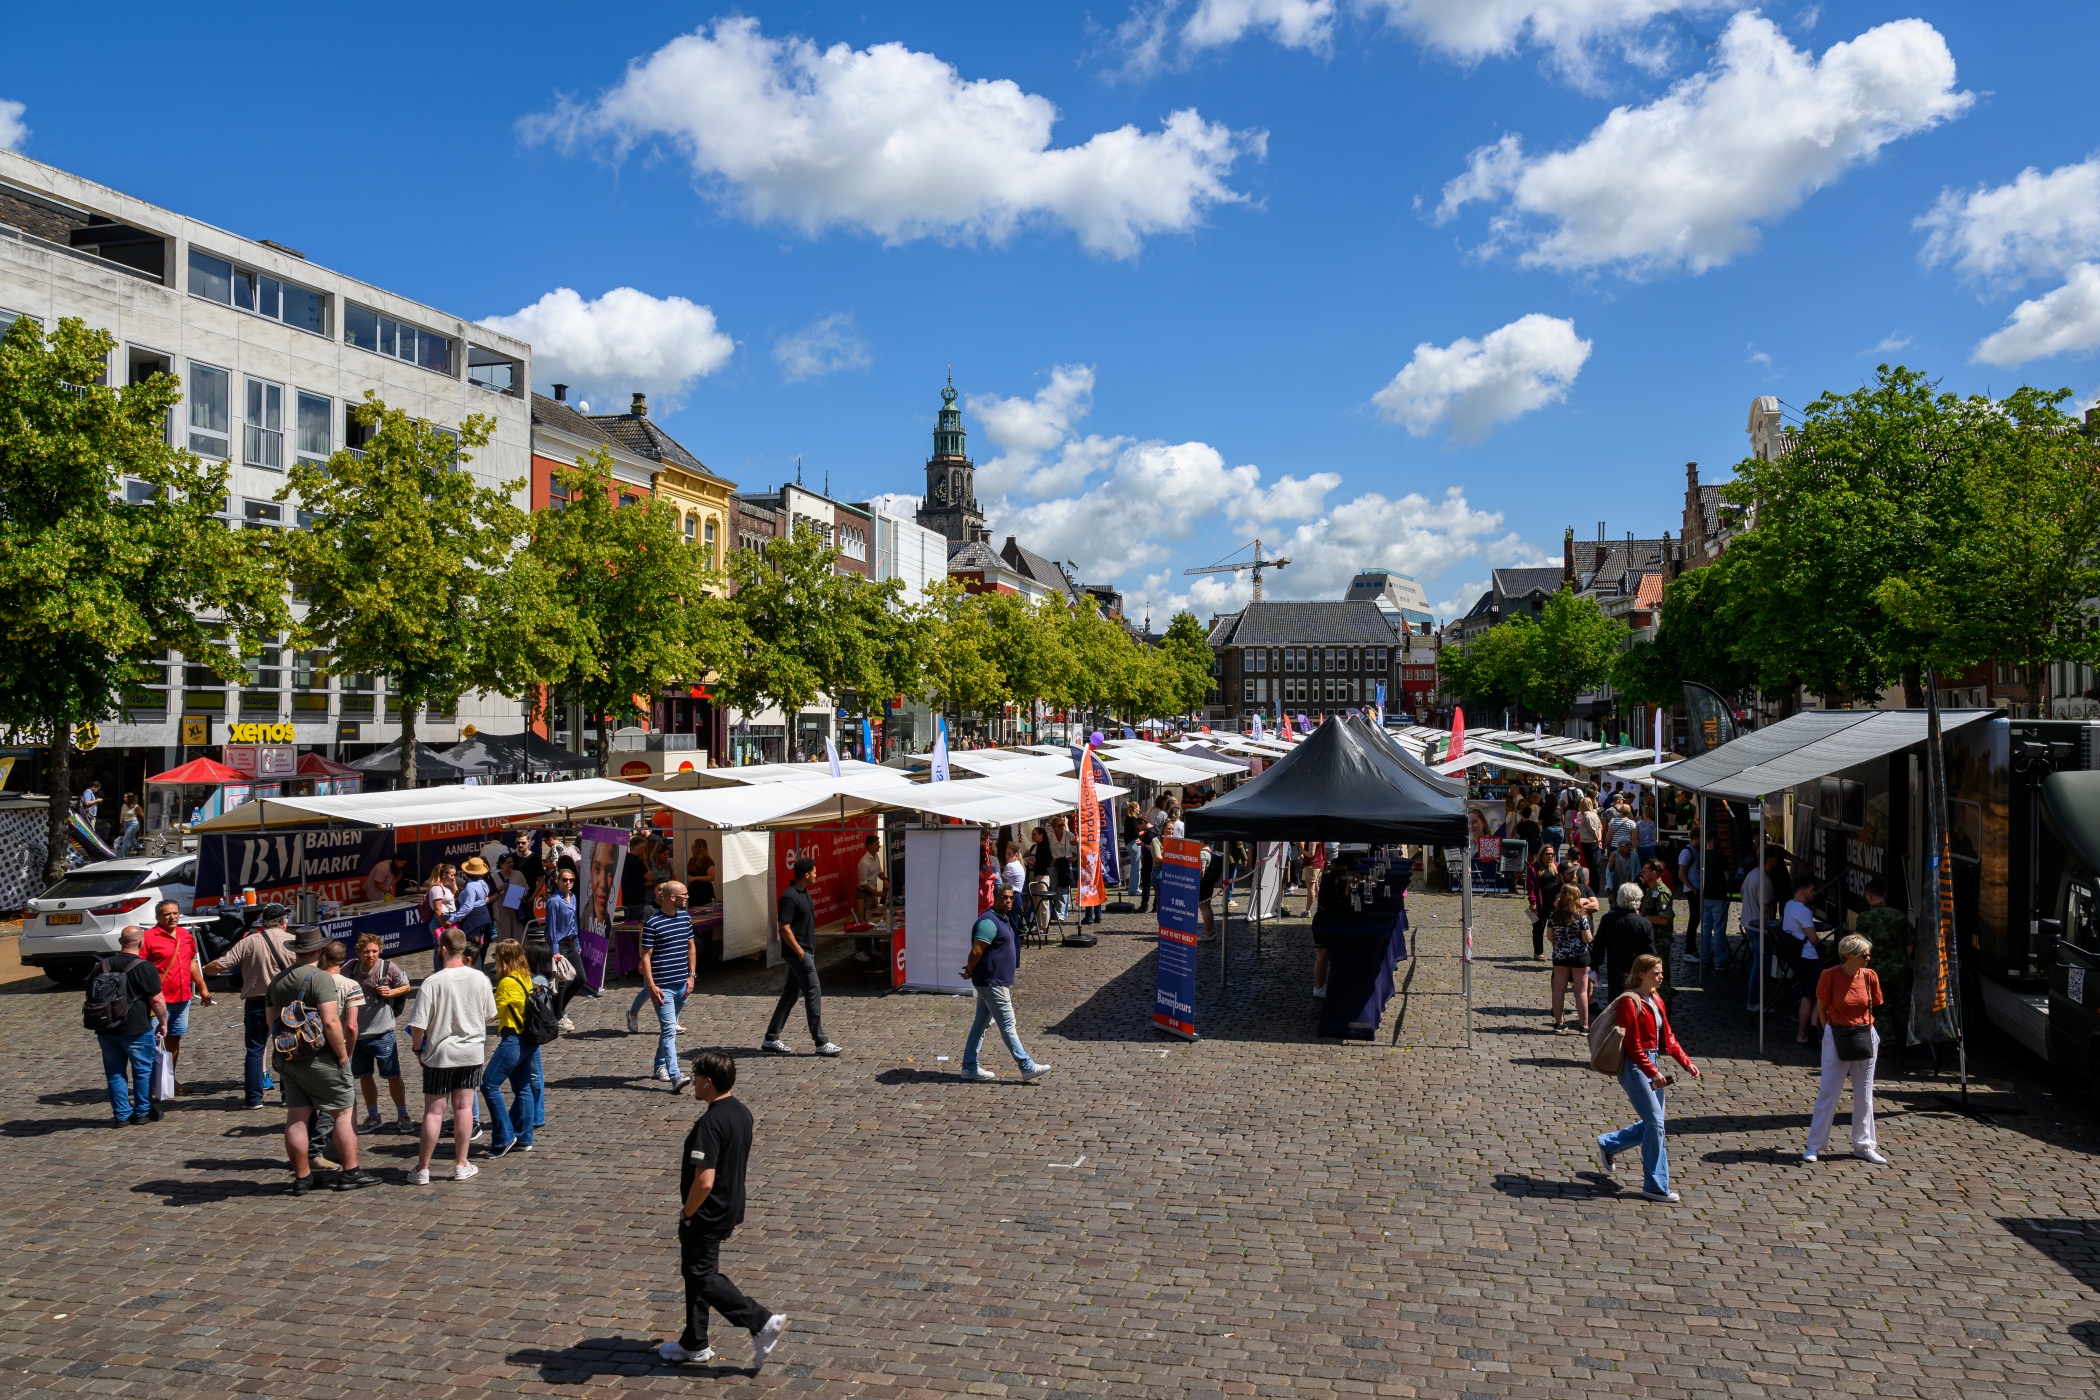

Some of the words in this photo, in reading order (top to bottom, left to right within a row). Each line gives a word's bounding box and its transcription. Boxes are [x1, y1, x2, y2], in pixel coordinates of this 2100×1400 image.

[188, 724, 203, 738] XL
[229, 722, 296, 742] xenos
[430, 820, 470, 835] FLIGHT
[305, 830, 363, 849] BANEN
[444, 841, 491, 856] AANMELD
[304, 854, 361, 876] MARKT
[258, 879, 361, 906] FORATIE
[332, 920, 353, 930] BANEN
[331, 929, 353, 939] MARKT
[1157, 991, 1192, 1016] Banenbeurs
